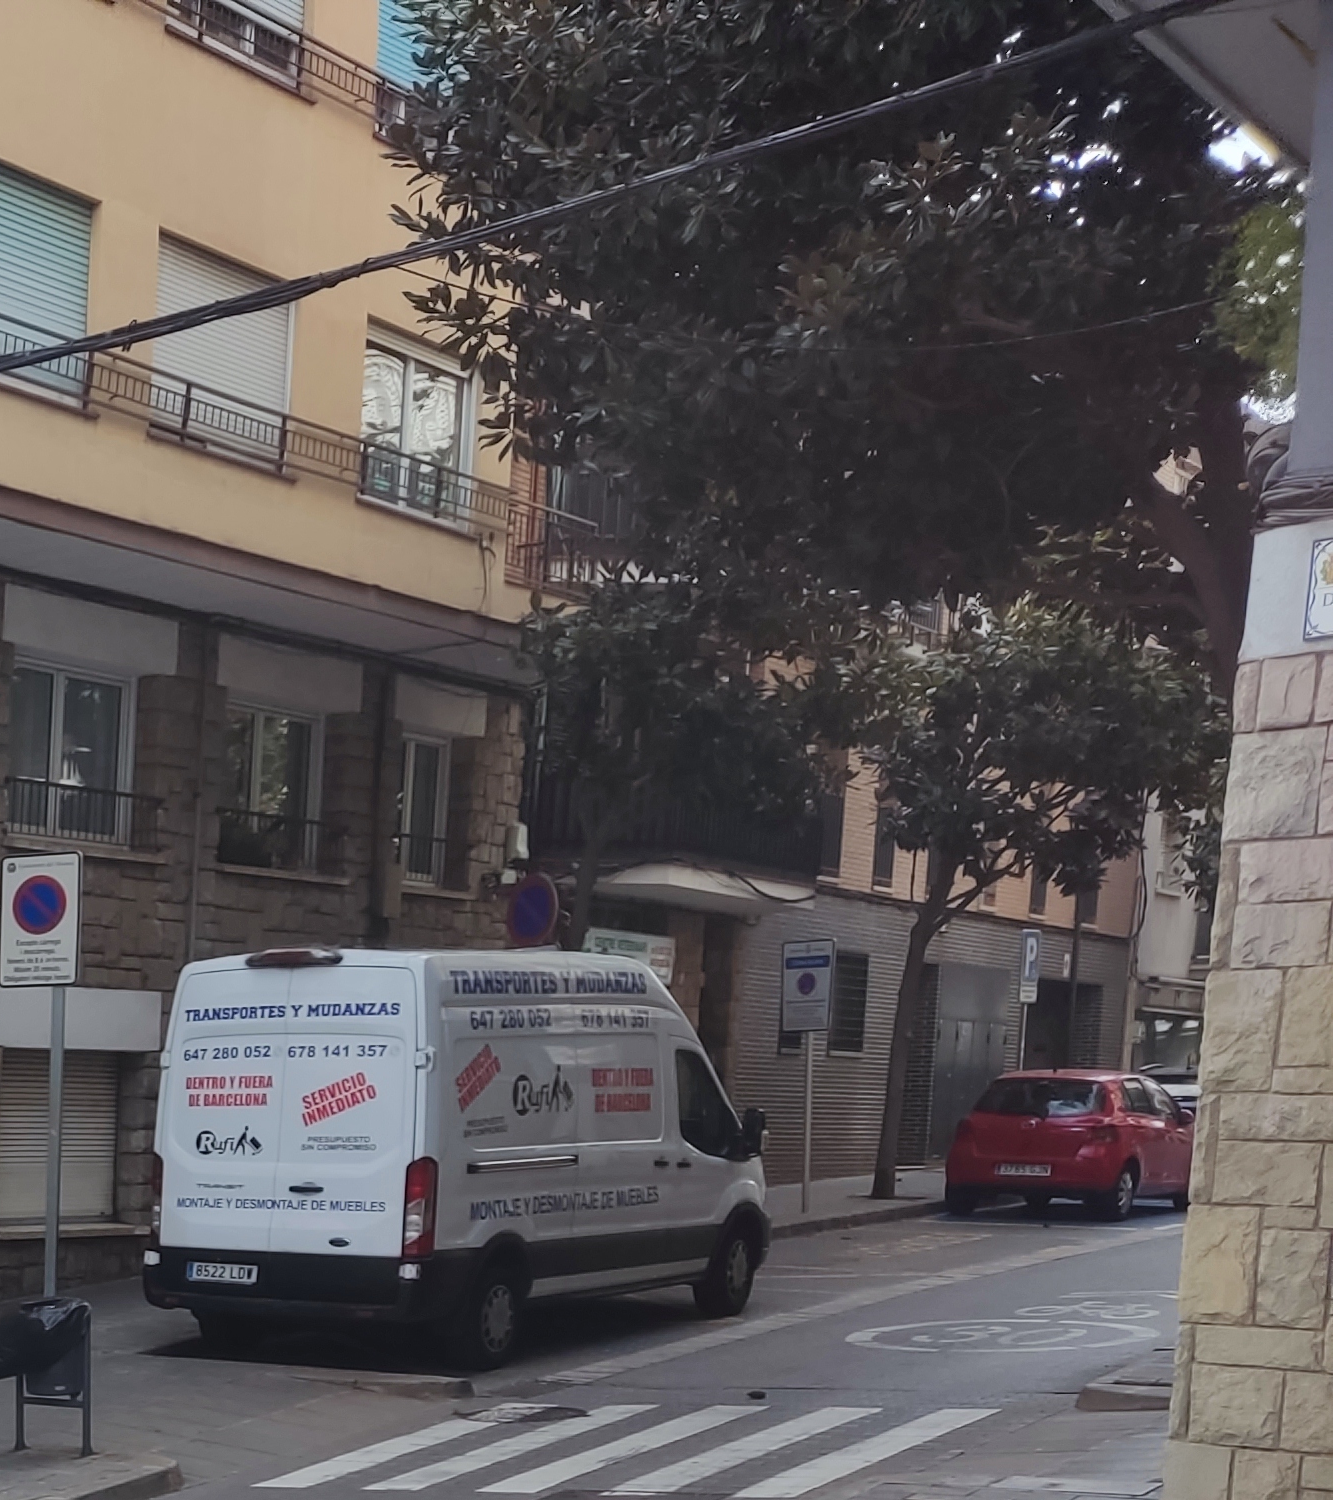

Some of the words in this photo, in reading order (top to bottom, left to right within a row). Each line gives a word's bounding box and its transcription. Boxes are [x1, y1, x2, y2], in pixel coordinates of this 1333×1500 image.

[450, 970, 558, 994] TRANSPORTES
[559, 972, 572, 994] Y
[576, 972, 647, 995] MUDANZAS
[185, 1005, 286, 1022] TRANSPORTES
[291, 1004, 303, 1018] Y
[307, 1002, 401, 1017] MUDANZAS
[470, 1010, 494, 1030] 647
[501, 1009, 525, 1028] 280
[529, 1008, 552, 1028] 052
[184, 1048, 207, 1061] 647
[212, 1047, 239, 1059] 280
[244, 1045, 271, 1058] 052
[287, 1046, 316, 1058] 678
[324, 1045, 350, 1057] 141
[357, 1044, 388, 1057] 357
[185, 1076, 226, 1090] DENTRO
[229, 1076, 236, 1090] Y
[238, 1075, 273, 1089] FUERA
[301, 1071, 367, 1110] SERVICIO
[188, 1093, 201, 1107] DE
[203, 1093, 268, 1107] BARCELONA
[301, 1084, 377, 1127] INMEDIATO
[177, 1197, 223, 1209] MONTAJE
[225, 1199, 233, 1209] Y
[235, 1199, 307, 1211] DESMONTAJE
[311, 1200, 327, 1211] DE
[329, 1200, 386, 1212] MUEBLES
[470, 1197, 522, 1221] MONTAJE
[196, 1265, 226, 1278] 8522
[911, 1326, 1087, 1346] 30
